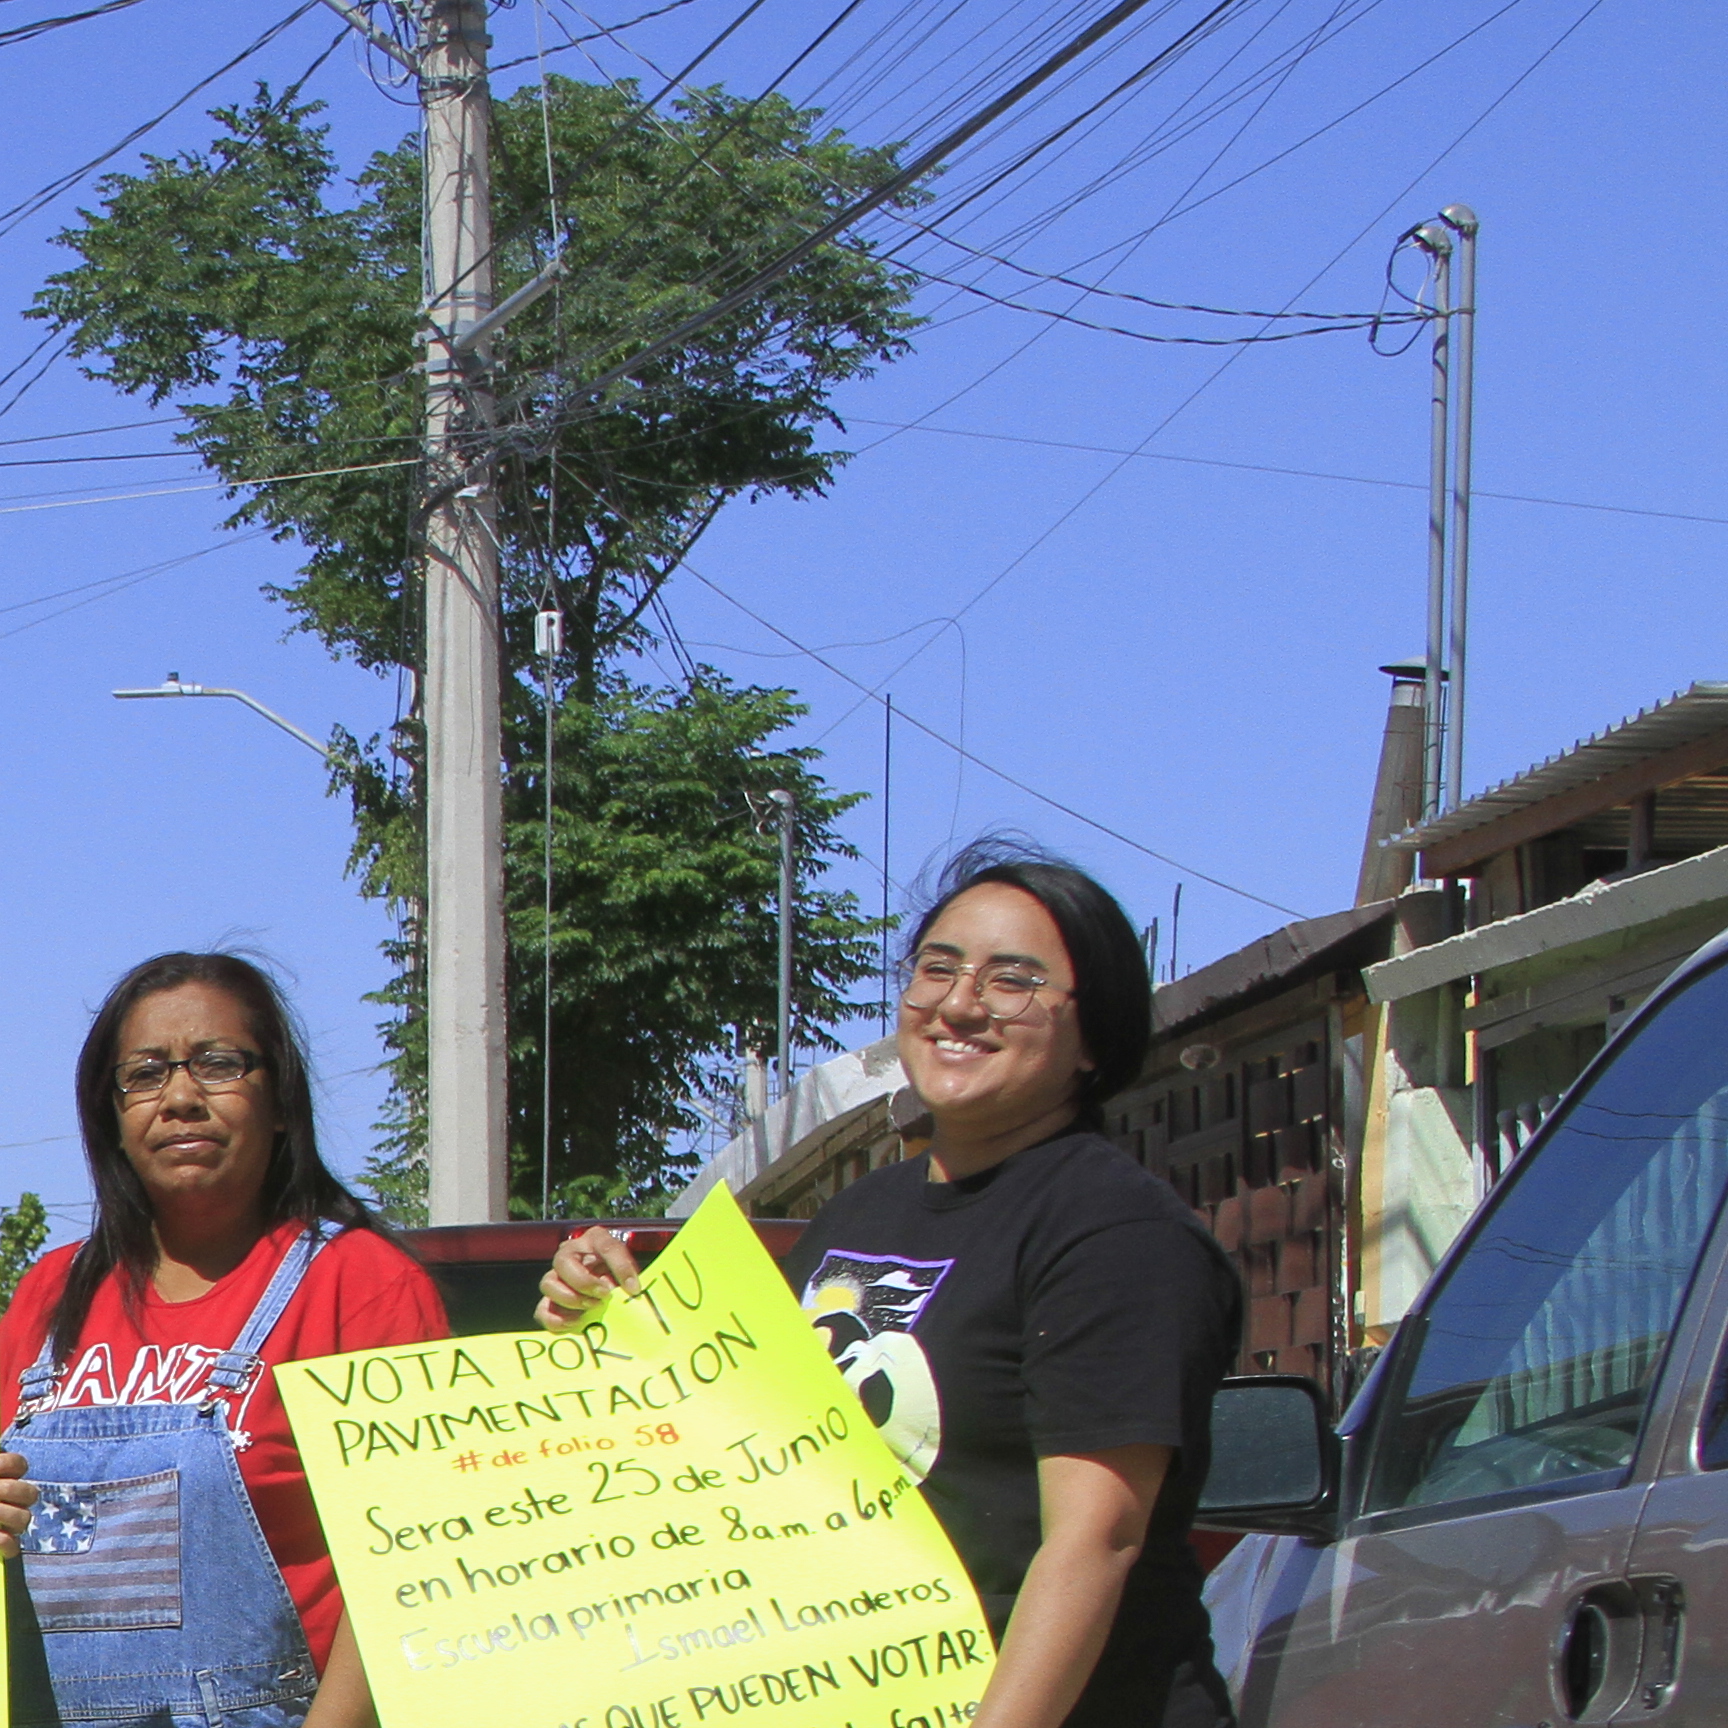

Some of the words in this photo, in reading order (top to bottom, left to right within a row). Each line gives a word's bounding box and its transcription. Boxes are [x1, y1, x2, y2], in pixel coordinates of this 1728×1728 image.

[302, 1348, 497, 1408] VOTA
[513, 1320, 635, 1381] POR
[622, 1249, 704, 1337] TU
[331, 1310, 759, 1468] PAVIMENTACION
[365, 1505, 475, 1556] Sera
[483, 1486, 574, 1529] este
[586, 1457, 662, 1505] 25
[671, 1463, 727, 1494] de
[724, 1405, 850, 1485] Junio
[490, 1448, 529, 1469] de
[538, 1434, 616, 1459] folio
[634, 1421, 680, 1448] 58
[394, 1575, 454, 1609] en
[454, 1534, 636, 1595] horario
[649, 1521, 707, 1551] de
[398, 1612, 562, 1673] Escuela
[565, 1567, 753, 1641] primaria
[617, 1606, 767, 1673] Ismael
[686, 1659, 842, 1722] PUEDEN
